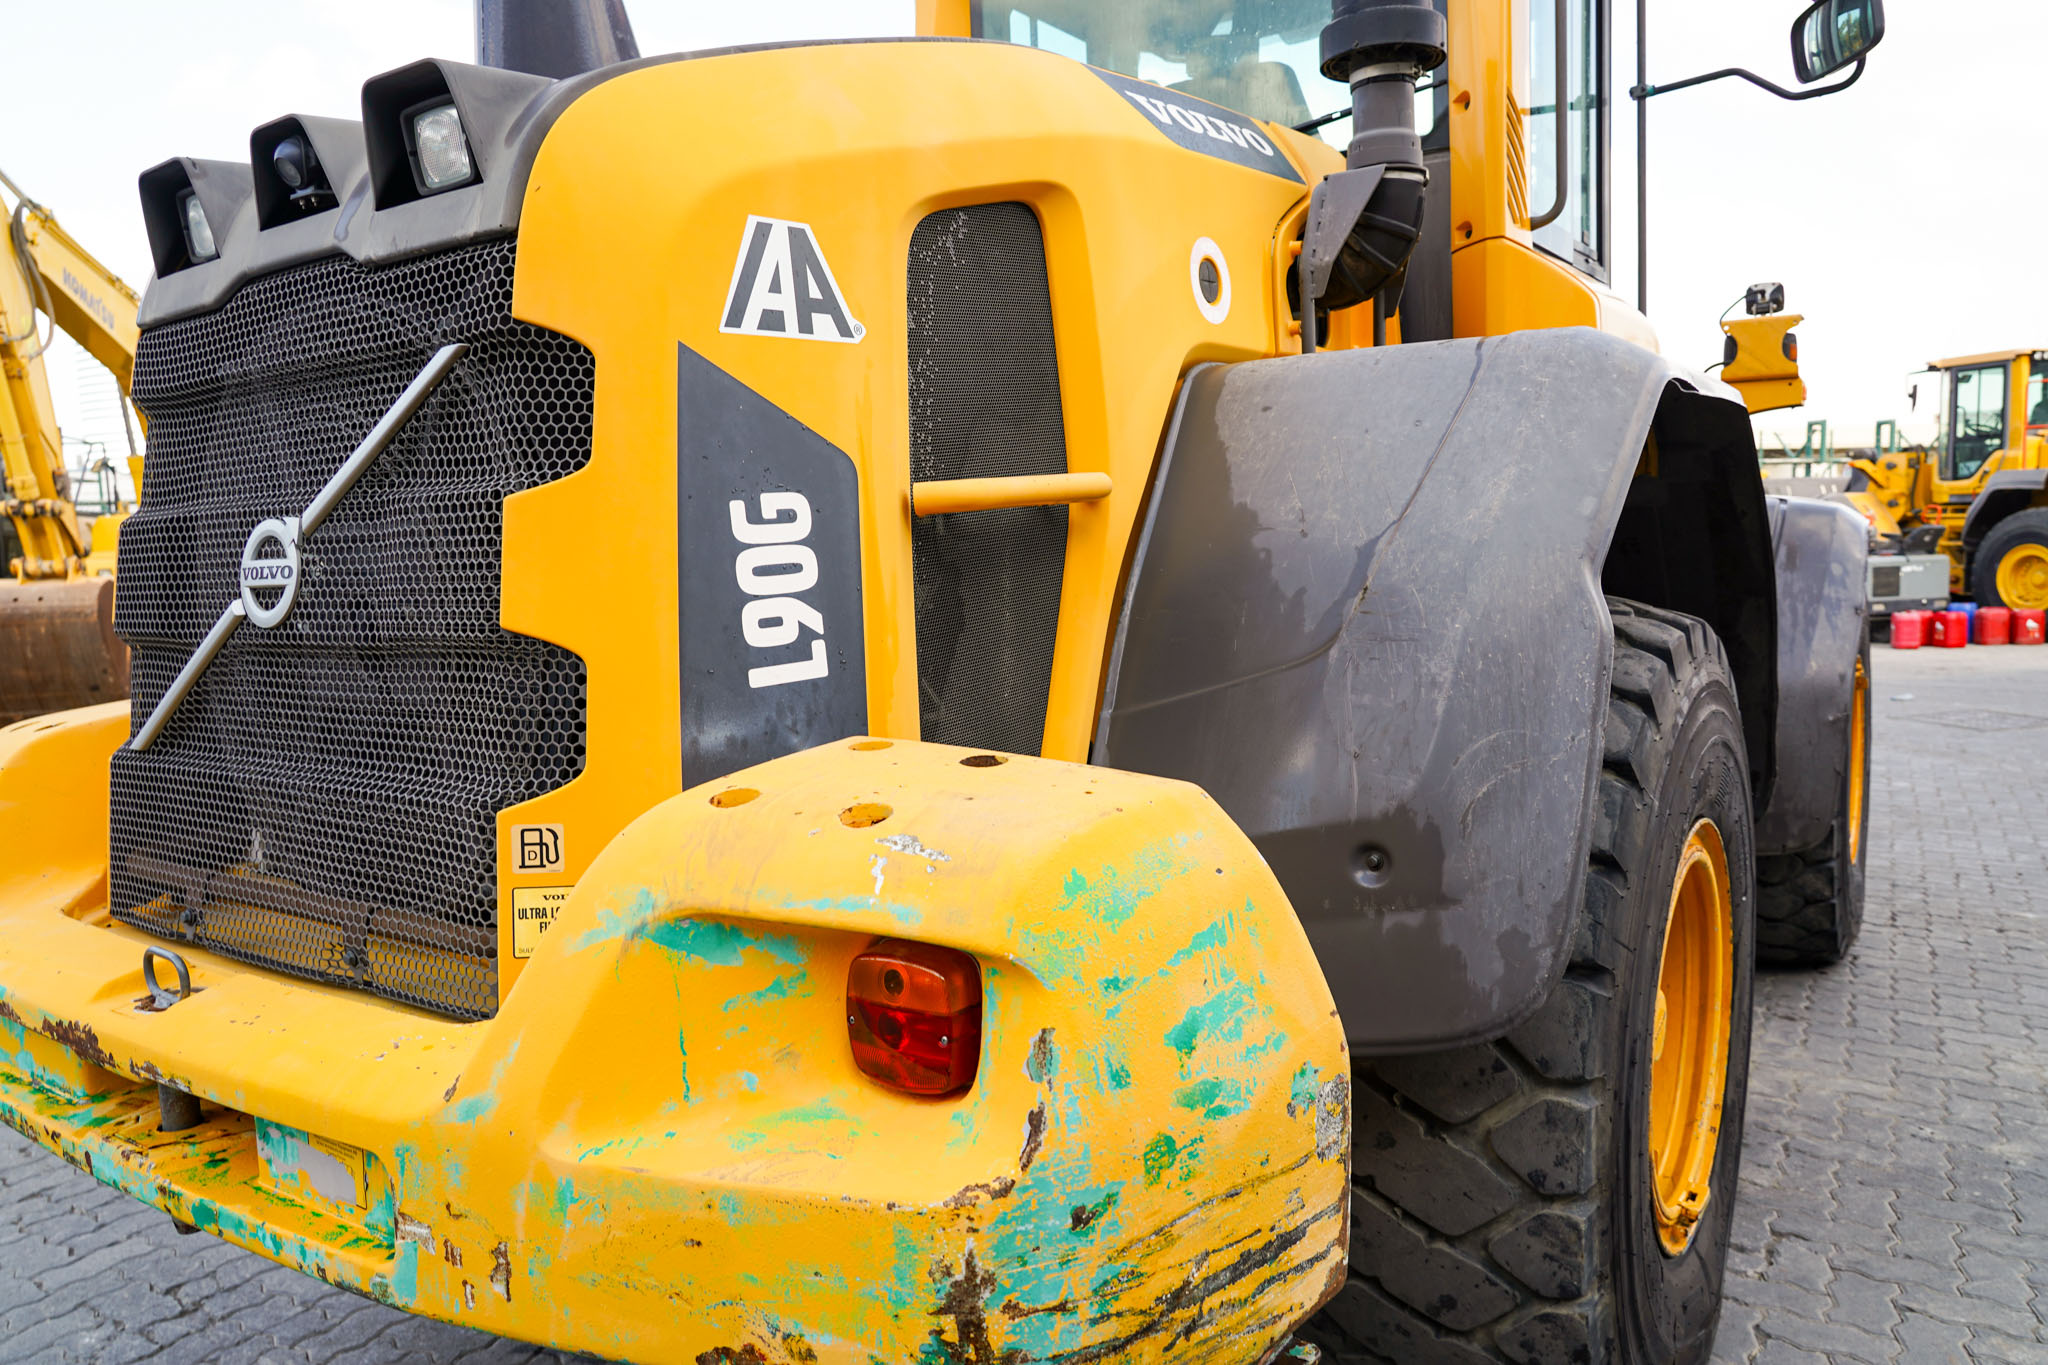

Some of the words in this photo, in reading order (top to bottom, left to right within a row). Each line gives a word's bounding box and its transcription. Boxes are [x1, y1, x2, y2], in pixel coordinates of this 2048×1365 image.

[1124, 90, 1274, 156] VOLVO
[242, 565, 294, 581] VOLVO
[729, 491, 829, 688] L90G
[528, 850, 538, 861] D
[518, 907, 548, 920] ULTRA
